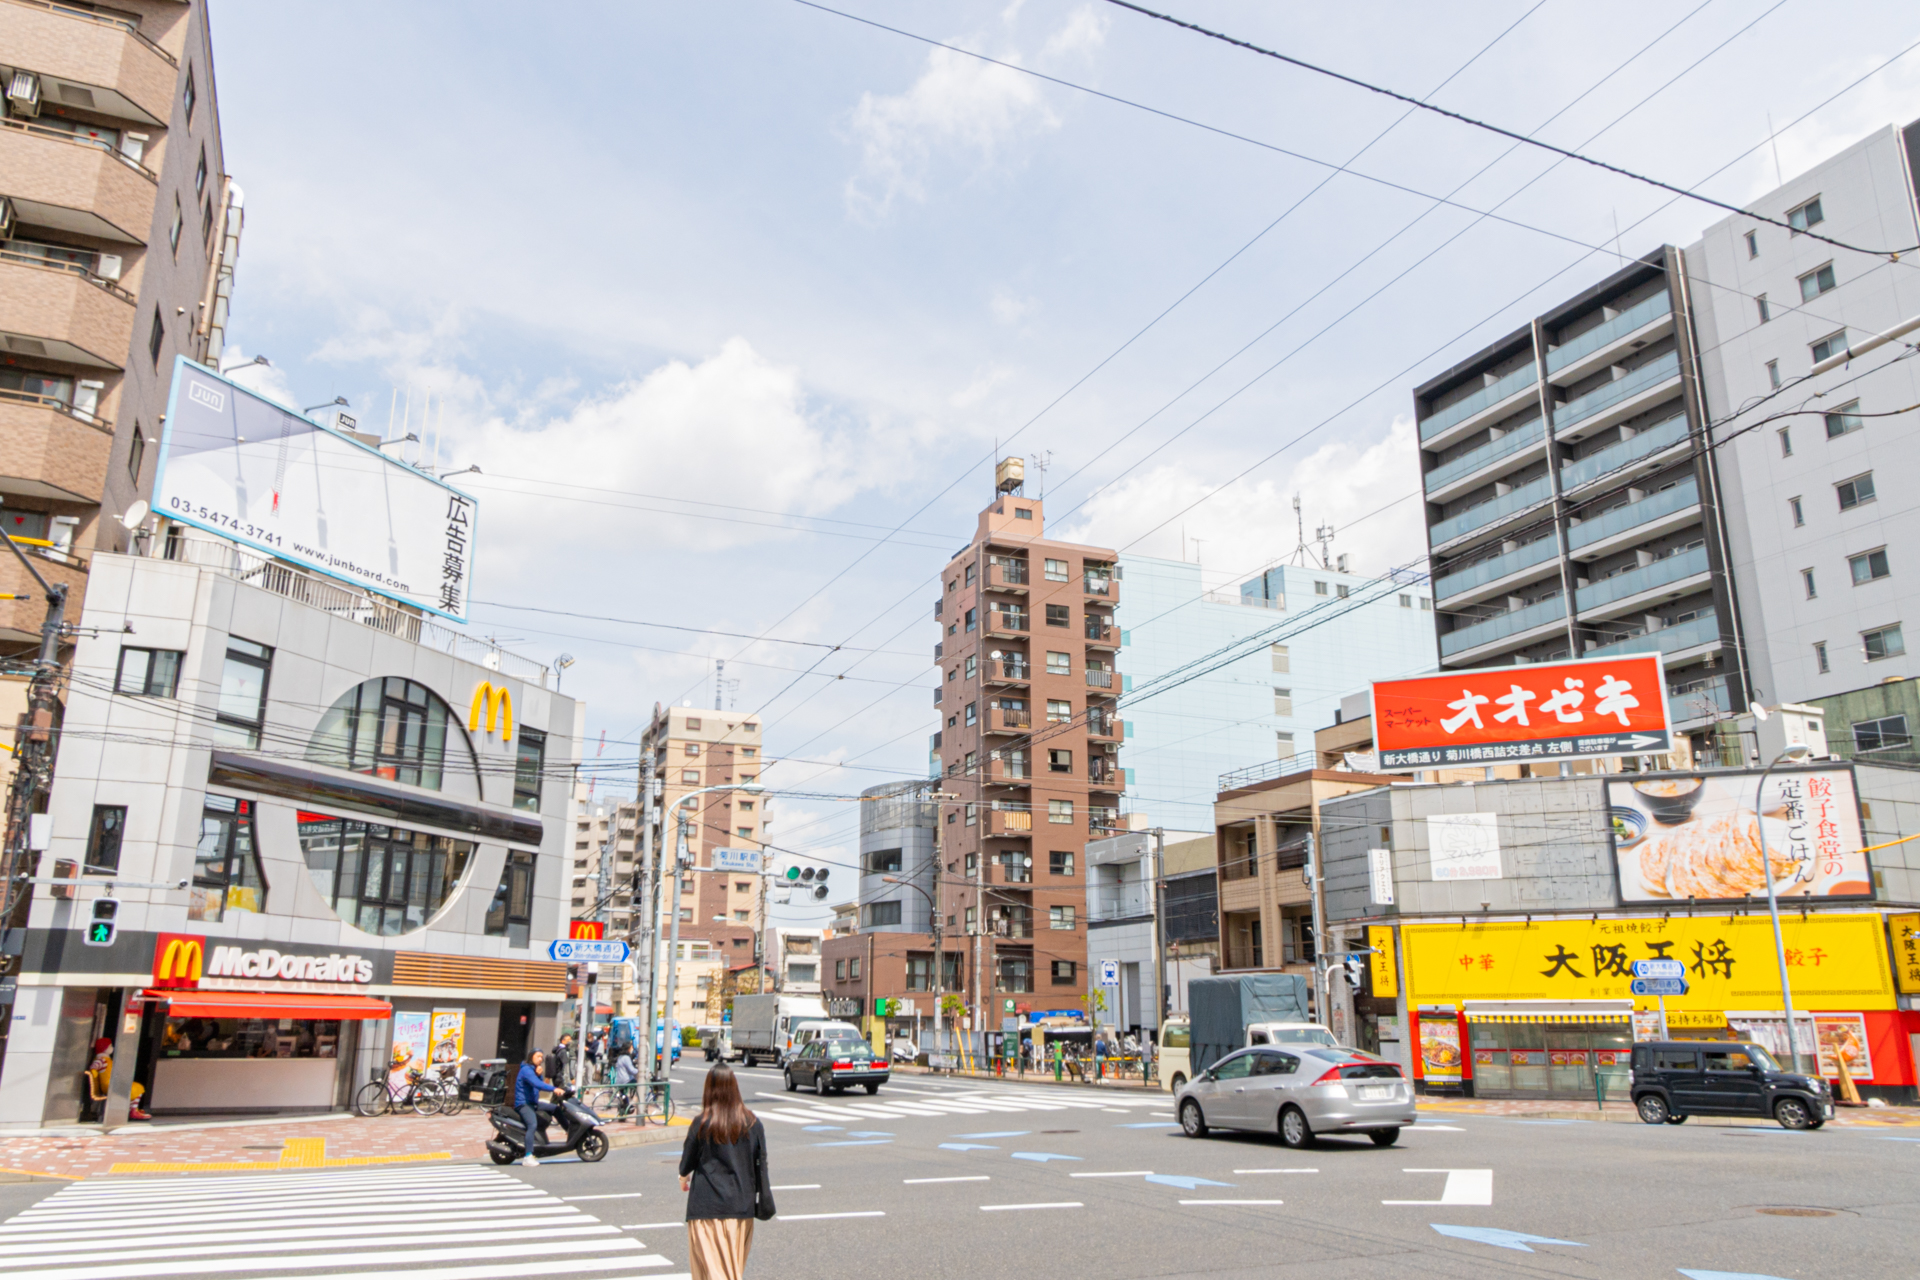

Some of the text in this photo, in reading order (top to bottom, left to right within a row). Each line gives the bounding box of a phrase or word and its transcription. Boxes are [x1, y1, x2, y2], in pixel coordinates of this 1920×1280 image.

[171, 496, 282, 547] 03-5474-3741
[438, 496, 470, 615] 広告募集
[293, 541, 410, 592] www.junboard.com
[1384, 707, 1422, 718] スーパー
[1440, 675, 1640, 734] オオゼキ
[1384, 717, 1431, 728] マーケット
[1384, 740, 1573, 765] 新大橋通り 菊川橋西詰交差点 左側
[1778, 779, 1815, 883] 定番ごはん
[1808, 777, 1843, 876] 餃子食堂の
[720, 851, 758, 862] 菊川駅前
[1599, 921, 1666, 934] 元祖焼餃子
[560, 945, 571, 955] 50
[575, 943, 621, 953] 新大橋通り
[1784, 948, 1828, 967] 餃子
[207, 946, 373, 983] McDonald's
[1459, 953, 1495, 972] 中華
[1667, 1013, 1723, 1025] お持ち帰り
